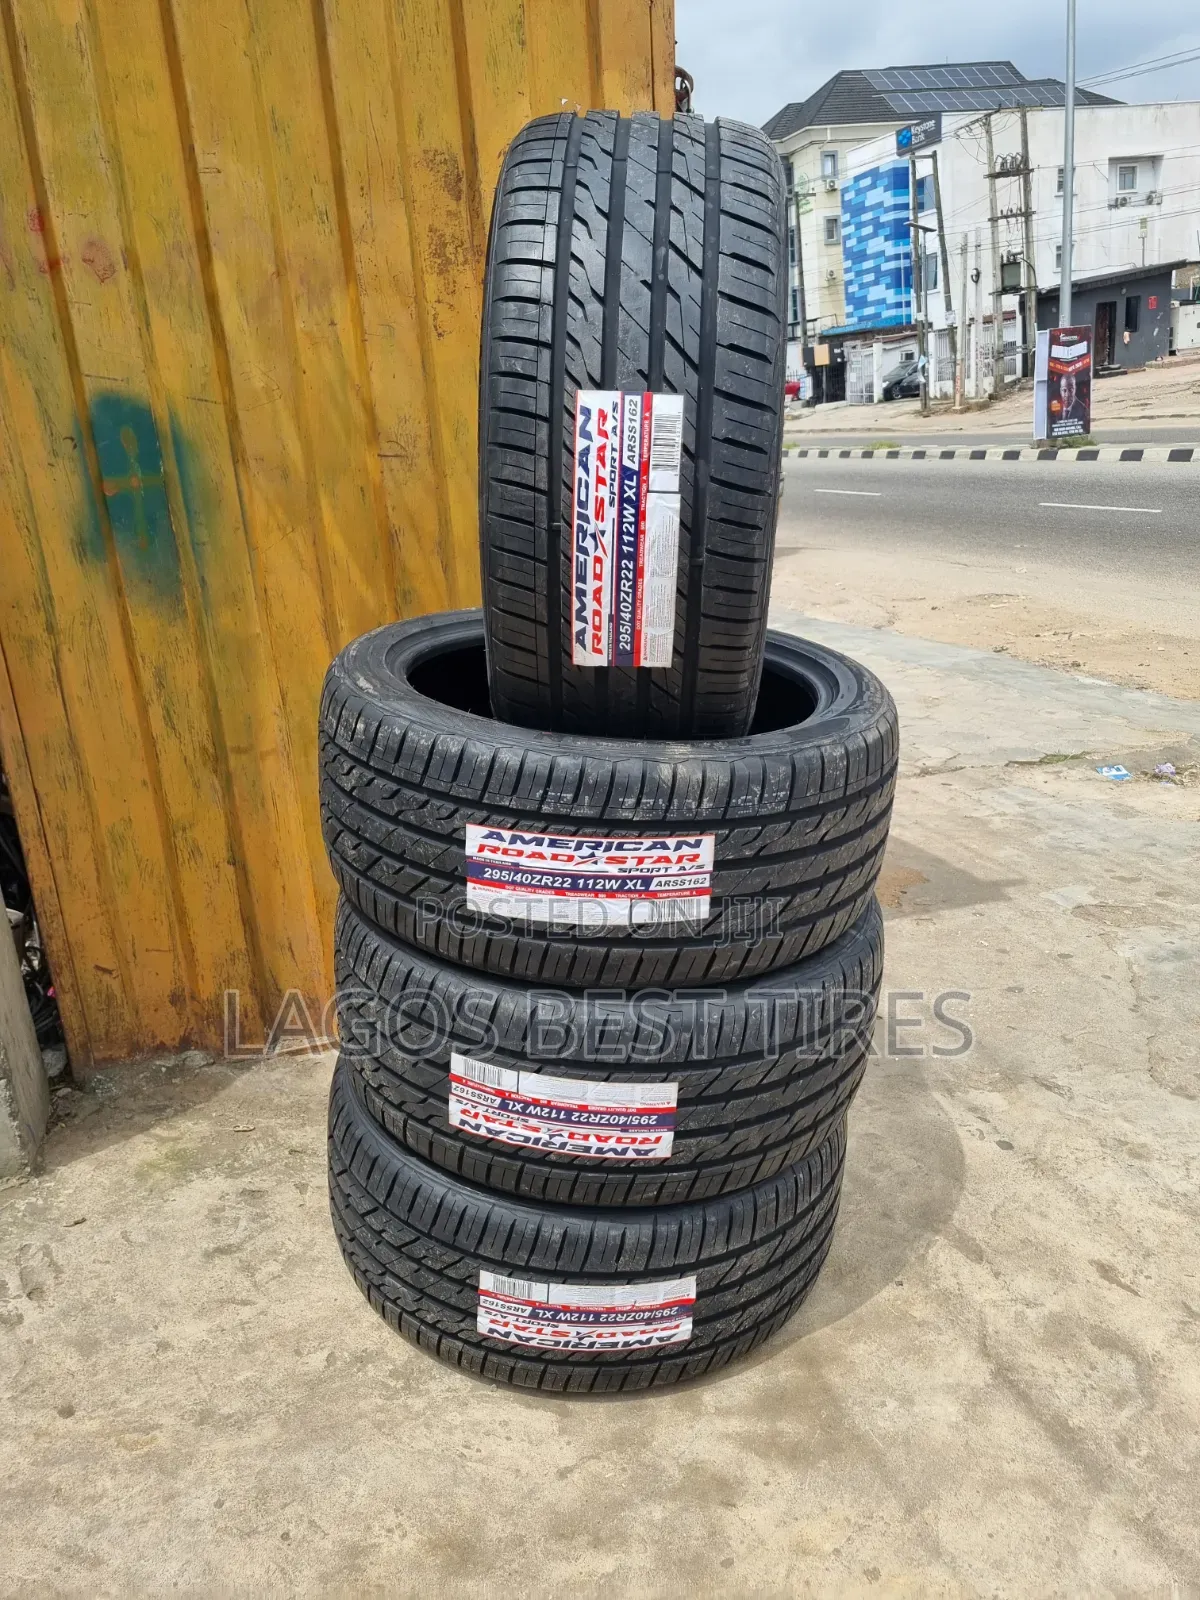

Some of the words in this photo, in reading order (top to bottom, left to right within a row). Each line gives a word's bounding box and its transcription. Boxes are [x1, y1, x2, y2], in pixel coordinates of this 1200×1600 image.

[911, 120, 936, 135] Keystone
[911, 132, 925, 145] Bank
[611, 401, 619, 437] A/S
[626, 399, 638, 464] ARSS162
[642, 420, 650, 461] TEMPERATURE
[594, 408, 609, 523] STAR
[608, 443, 617, 508] SPORT
[623, 475, 636, 501] XL
[575, 405, 593, 651] AMERICAN
[622, 503, 634, 553] 112W
[592, 555, 604, 655] ROAD
[619, 560, 633, 651] 295/40ZR22
[480, 829, 703, 852] AMERICAN
[477, 844, 576, 862] ROAD
[604, 853, 701, 866] STAR
[483, 868, 571, 888] 295/40ZR22
[577, 878, 621, 890] 112W
[624, 879, 646, 890] XL
[655, 878, 706, 888] ARSS162
[617, 866, 672, 874] SPORT
[677, 864, 705, 872] A/S
[657, 890, 690, 898] TEMPERATURE
[453, 1085, 496, 1105] ARSS162
[455, 1098, 478, 1110] A/S
[482, 1107, 530, 1124] SPORT
[504, 1100, 524, 1112] XL
[526, 1106, 567, 1119] 112W
[460, 1108, 542, 1133] STAR
[571, 1112, 658, 1124] 295/40ZR22
[458, 1118, 657, 1156] AMERICAN
[567, 1132, 662, 1145] ROAD
[482, 1300, 528, 1313] ARSS162
[535, 1310, 554, 1318] XL
[600, 1306, 679, 1322] 295/40ZR22
[512, 1318, 560, 1328] SPORT
[556, 1312, 595, 1322] 112W
[488, 1318, 571, 1338] STAR
[596, 1322, 682, 1338] ROAD
[487, 1328, 678, 1350] AMERICAN
